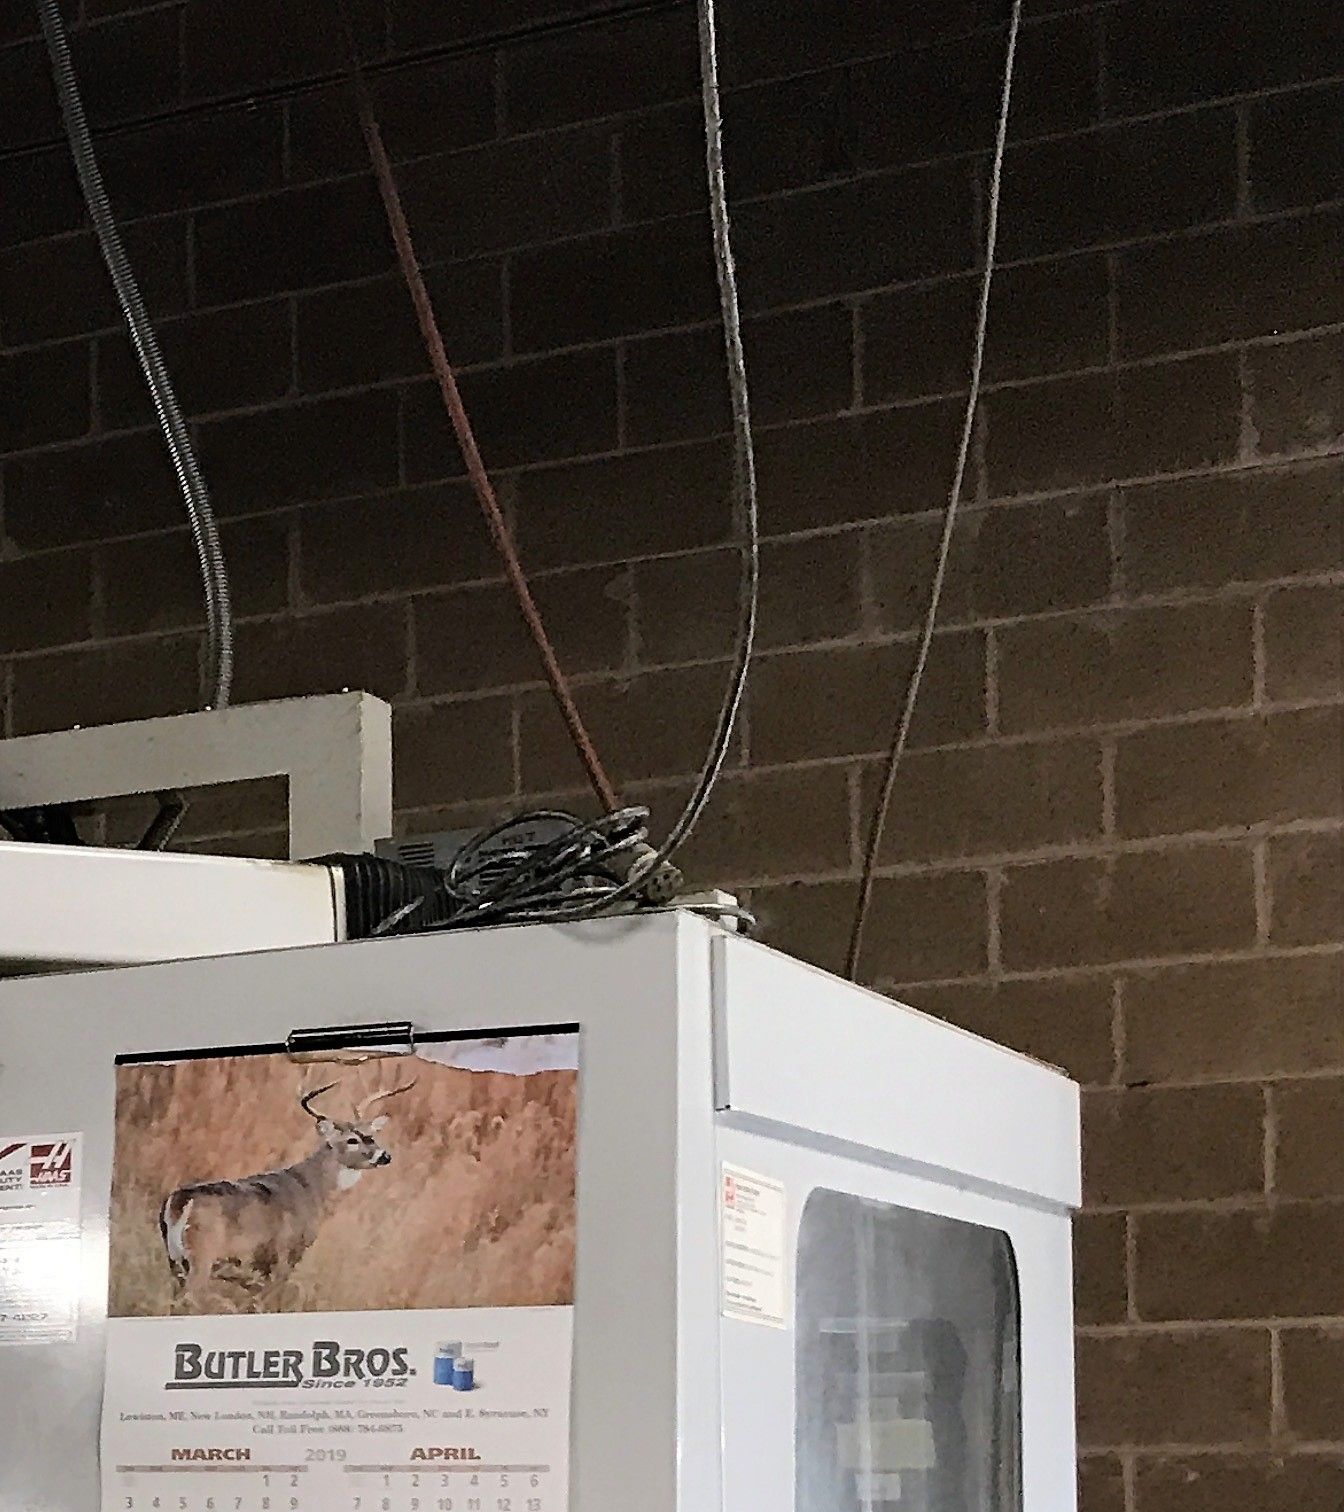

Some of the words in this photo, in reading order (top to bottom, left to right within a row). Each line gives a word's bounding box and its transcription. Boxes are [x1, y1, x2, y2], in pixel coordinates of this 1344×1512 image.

[301, 1379, 357, 1389] Since
[362, 1378, 409, 1388] 1952
[172, 1448, 251, 1460] MARCH
[305, 1449, 346, 1461] 2019
[410, 1448, 481, 1460] APRIL
